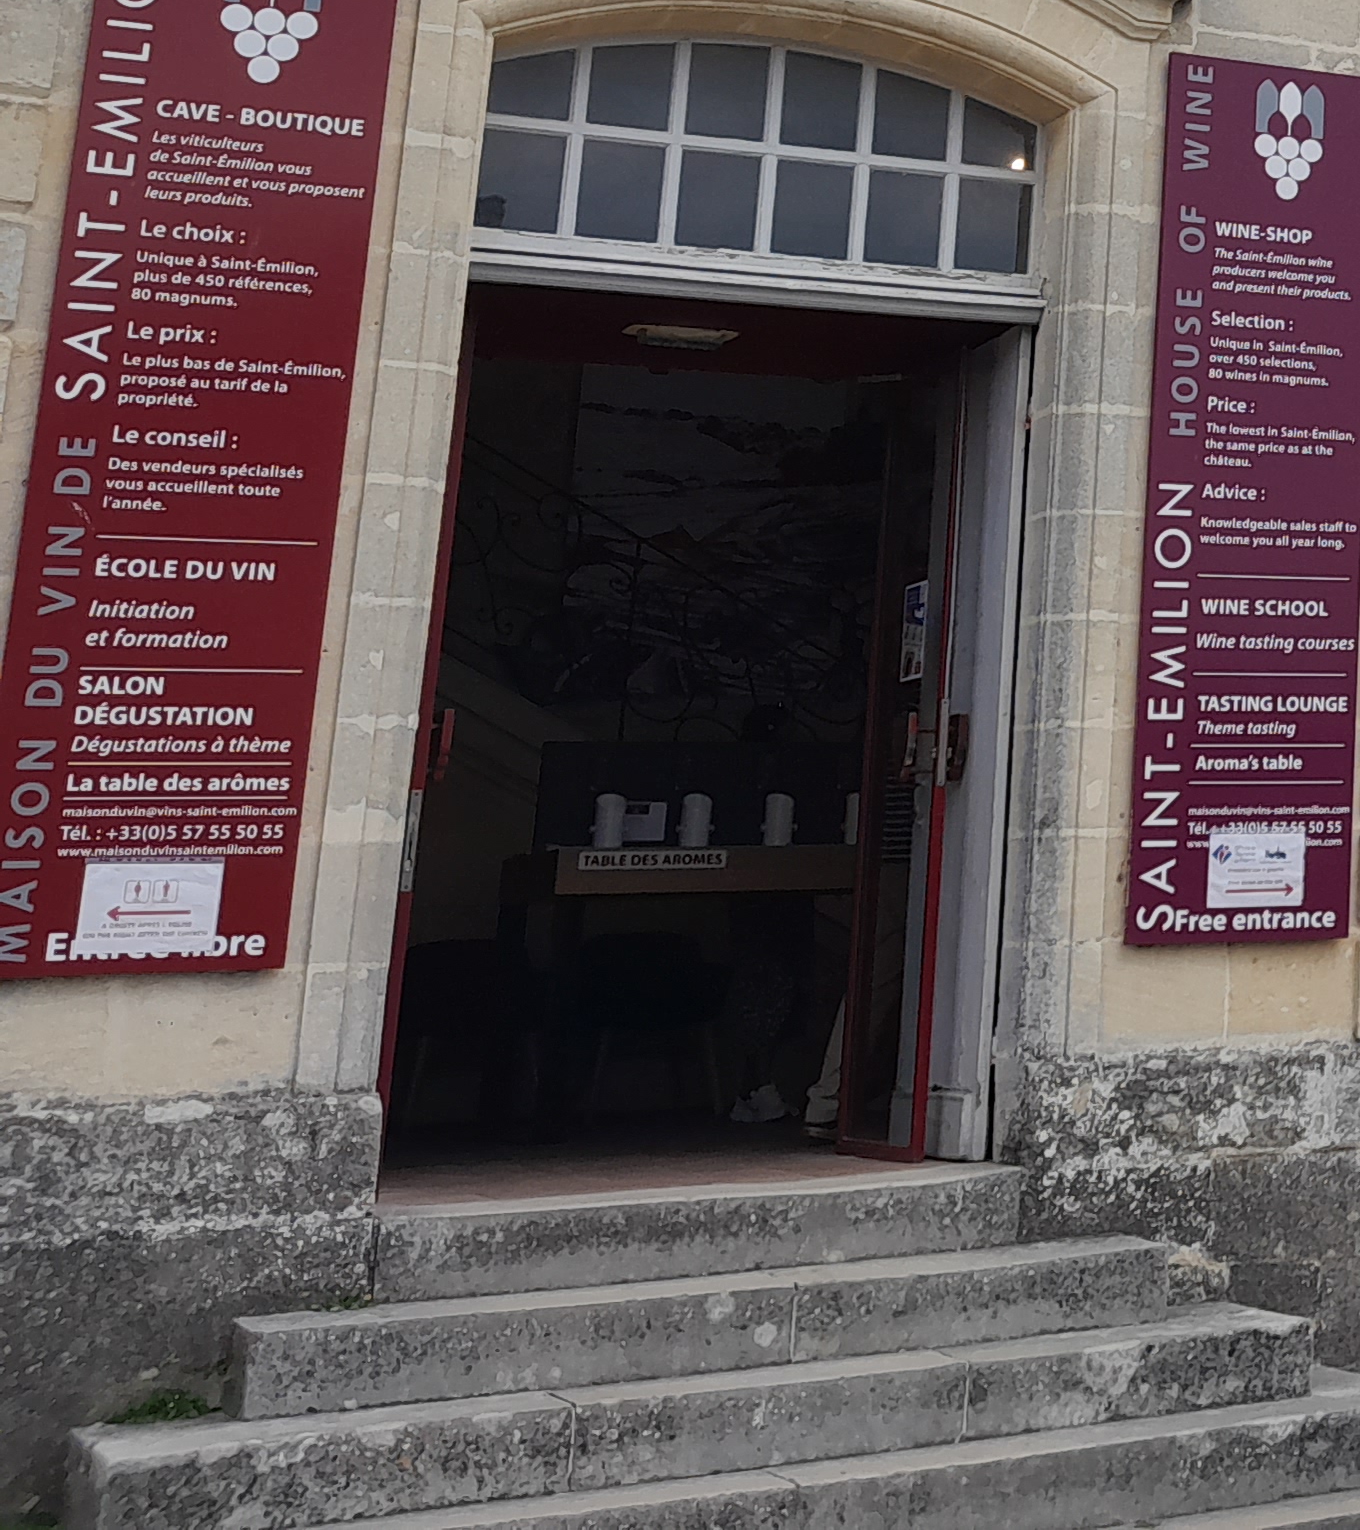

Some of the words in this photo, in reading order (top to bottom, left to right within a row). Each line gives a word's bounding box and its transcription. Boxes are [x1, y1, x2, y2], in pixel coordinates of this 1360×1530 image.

[155, 99, 221, 123] CAVE
[239, 107, 365, 137] BOUTIQUE
[1182, 63, 1214, 171] WINE
[151, 130, 177, 145] Les
[179, 133, 264, 153] viticulteurs
[148, 148, 170, 163] de
[171, 150, 274, 172] Saint-Émilion
[277, 163, 312, 176] vous
[146, 170, 231, 187] accueillent
[232, 176, 249, 188] et
[251, 179, 286, 192] vous
[287, 182, 365, 198] proposent
[143, 185, 182, 201] leurs
[182, 191, 252, 207] produits.
[139, 218, 167, 238] Le
[171, 221, 234, 244] choix
[1179, 205, 1207, 253] OF
[1214, 220, 1313, 244] WINE-SHOP
[135, 250, 194, 268] Unique
[196, 254, 207, 268] à
[210, 255, 318, 277] Saint-Émilion,
[1214, 246, 1234, 260] The
[1307, 256, 1333, 268] wine
[132, 268, 168, 284] plus
[170, 271, 192, 285] de
[194, 273, 225, 287] 450
[227, 275, 313, 295] références,
[1211, 264, 1266, 278] producers
[1267, 268, 1314, 282] welcome
[1314, 274, 1336, 285] you
[130, 287, 152, 301] 80
[154, 291, 237, 307] magnums.
[1211, 279, 1234, 291] and
[1233, 282, 1275, 294] present
[1276, 283, 1302, 296] their
[1301, 287, 1351, 301] products.
[1210, 310, 1285, 331] Selection
[126, 320, 154, 340] Le
[158, 324, 205, 345] prix
[1252, 338, 1264, 351] in
[122, 352, 142, 366] Le
[144, 353, 179, 369] plus
[182, 355, 211, 370] bas
[213, 357, 235, 372] de
[237, 359, 346, 380] Saint-Émilion,
[1169, 288, 1202, 437] HOUSE
[1208, 353, 1234, 364] over
[1235, 354, 1257, 366] 450
[119, 373, 187, 389] proposé
[189, 377, 210, 389] au
[213, 377, 248, 391] tarif
[249, 378, 271, 392] de
[273, 379, 288, 393] la
[1207, 367, 1223, 379] 80
[1224, 368, 1257, 382] wines
[1258, 370, 1270, 382] in
[1271, 374, 1329, 387] magnums.
[116, 392, 198, 407] propriété.
[1206, 395, 1247, 413] Price
[111, 424, 139, 444] Le
[143, 429, 226, 448] conseil
[1205, 421, 1227, 434] The
[1266, 425, 1278, 437] in
[1204, 437, 1224, 450] the
[1225, 441, 1256, 452] same
[1257, 441, 1285, 454] price
[1286, 444, 1299, 454] as
[1300, 444, 1313, 455] at
[1314, 443, 1333, 456] the
[53, 436, 97, 495] DE
[107, 456, 138, 471] Des
[141, 459, 216, 475] vendeurs
[219, 463, 303, 479] spécialisés
[105, 478, 144, 491] vous
[146, 479, 234, 495] accueillent
[237, 483, 281, 497] toute
[1201, 482, 1257, 500] Advice
[102, 494, 167, 511] l'année.
[1200, 516, 1288, 532] Knowledgeable
[1289, 519, 1317, 532] sales
[1318, 520, 1344, 532] staff
[1344, 522, 1357, 533] to
[1199, 532, 1250, 545] welcome
[1251, 536, 1274, 548] you
[1274, 534, 1289, 546] all
[1291, 538, 1315, 549] year
[37, 526, 86, 616] VIN
[94, 553, 178, 579] ÉCOLE
[184, 560, 224, 580] DU
[230, 561, 276, 581] VIN
[87, 599, 195, 620] Initiation
[1200, 598, 1249, 615] WINE
[1253, 599, 1329, 617] SCHOOL
[84, 629, 108, 647] et
[112, 627, 228, 649] formation
[1196, 632, 1236, 649] Wine
[1238, 633, 1294, 654] tasting
[1296, 637, 1355, 651] courses
[24, 646, 70, 707] DU
[77, 675, 165, 695] SALON
[73, 701, 254, 726] DÉGUSTATION
[1136, 483, 1194, 931] SAINT-EMILION
[1197, 694, 1273, 712] TASTING
[1276, 695, 1348, 712] LOUNGE
[1197, 719, 1245, 735] Theme
[1246, 720, 1296, 739] tasting
[70, 735, 207, 757] Dégustations
[210, 735, 225, 753] à
[228, 735, 291, 753] thème
[1194, 754, 1259, 771] Aroma's
[1261, 753, 1303, 770] table
[65, 773, 93, 792] La
[99, 772, 158, 792] table
[162, 772, 203, 792] des
[206, 772, 290, 791] arômes
[59, 824, 91, 841] Tél.
[181, 824, 205, 840] 57
[207, 824, 231, 840] 55
[234, 823, 258, 840] 50
[261, 823, 284, 839] 55
[1187, 820, 1210, 835] Tél.
[1307, 820, 1324, 834] 50
[1325, 819, 1342, 834] 55
[0, 739, 58, 963] MAISON
[584, 854, 627, 866] TABLE
[631, 854, 658, 866] DES
[1175, 908, 1227, 931] Free
[1232, 908, 1337, 930] entrance
